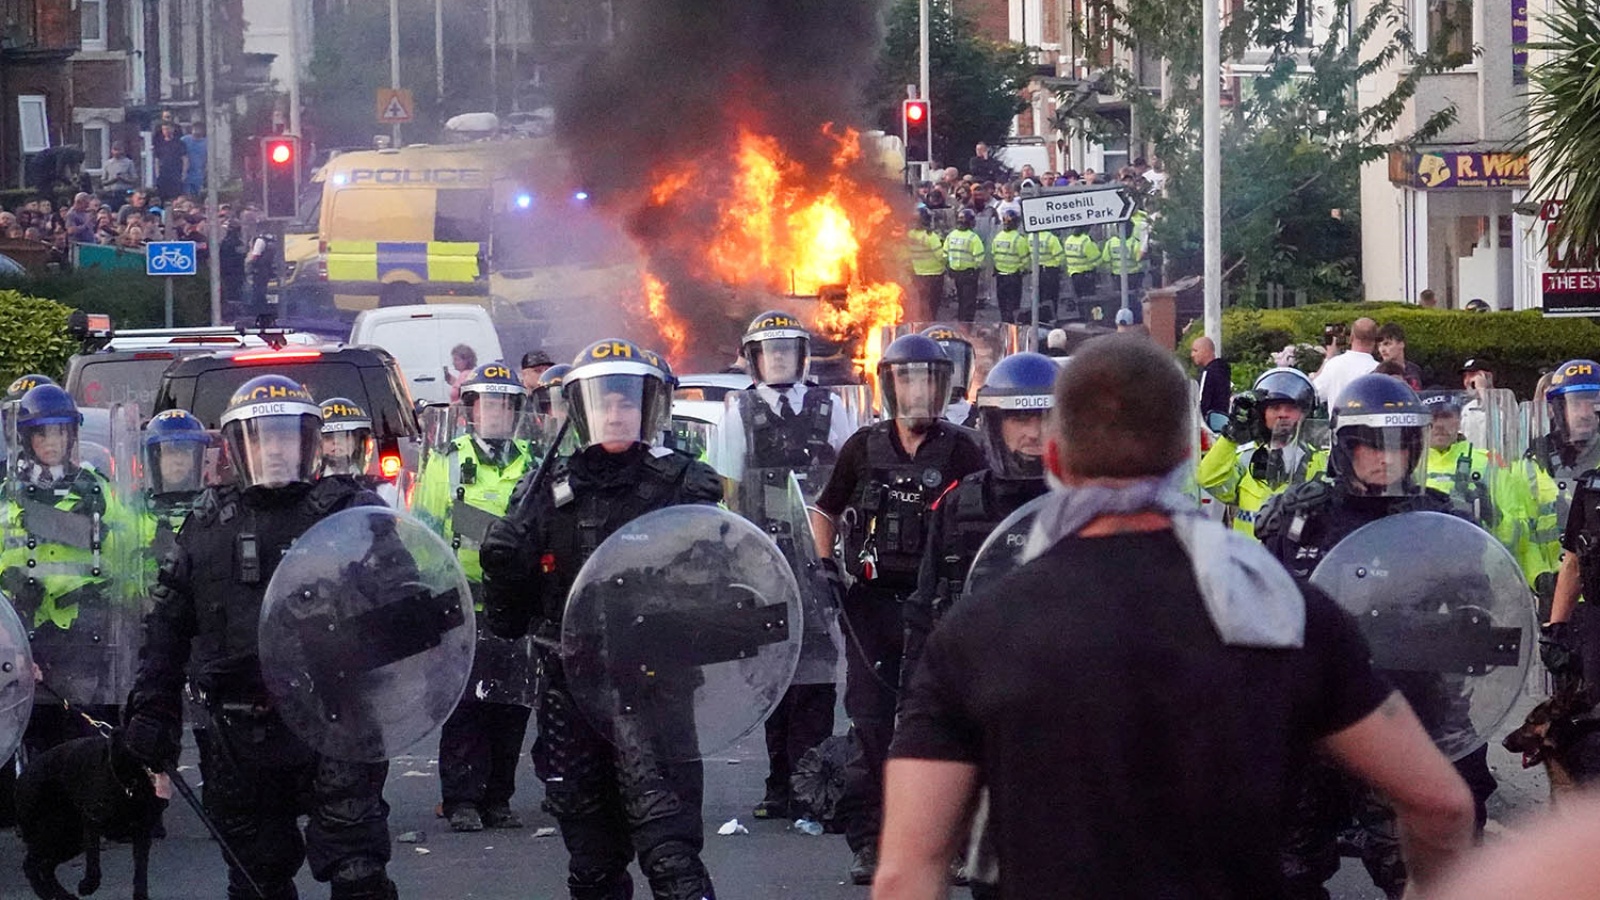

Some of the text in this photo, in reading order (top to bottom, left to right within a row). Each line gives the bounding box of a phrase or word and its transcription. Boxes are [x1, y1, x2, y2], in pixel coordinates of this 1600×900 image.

[1457, 154, 1478, 178] R.
[351, 168, 481, 184] POLICE
[1046, 197, 1094, 211] Rosehill
[1029, 207, 1114, 226] Business Park
[1548, 276, 1578, 290] THE
[591, 343, 632, 359] CH
[484, 366, 511, 379] CH
[1565, 364, 1593, 377] CH
[485, 384, 508, 392] POLICE
[251, 403, 291, 416] POLICE
[1014, 397, 1050, 408] POLICE
[322, 404, 348, 420] CH
[1384, 415, 1418, 425] POLICE
[888, 490, 921, 504] POLICE
